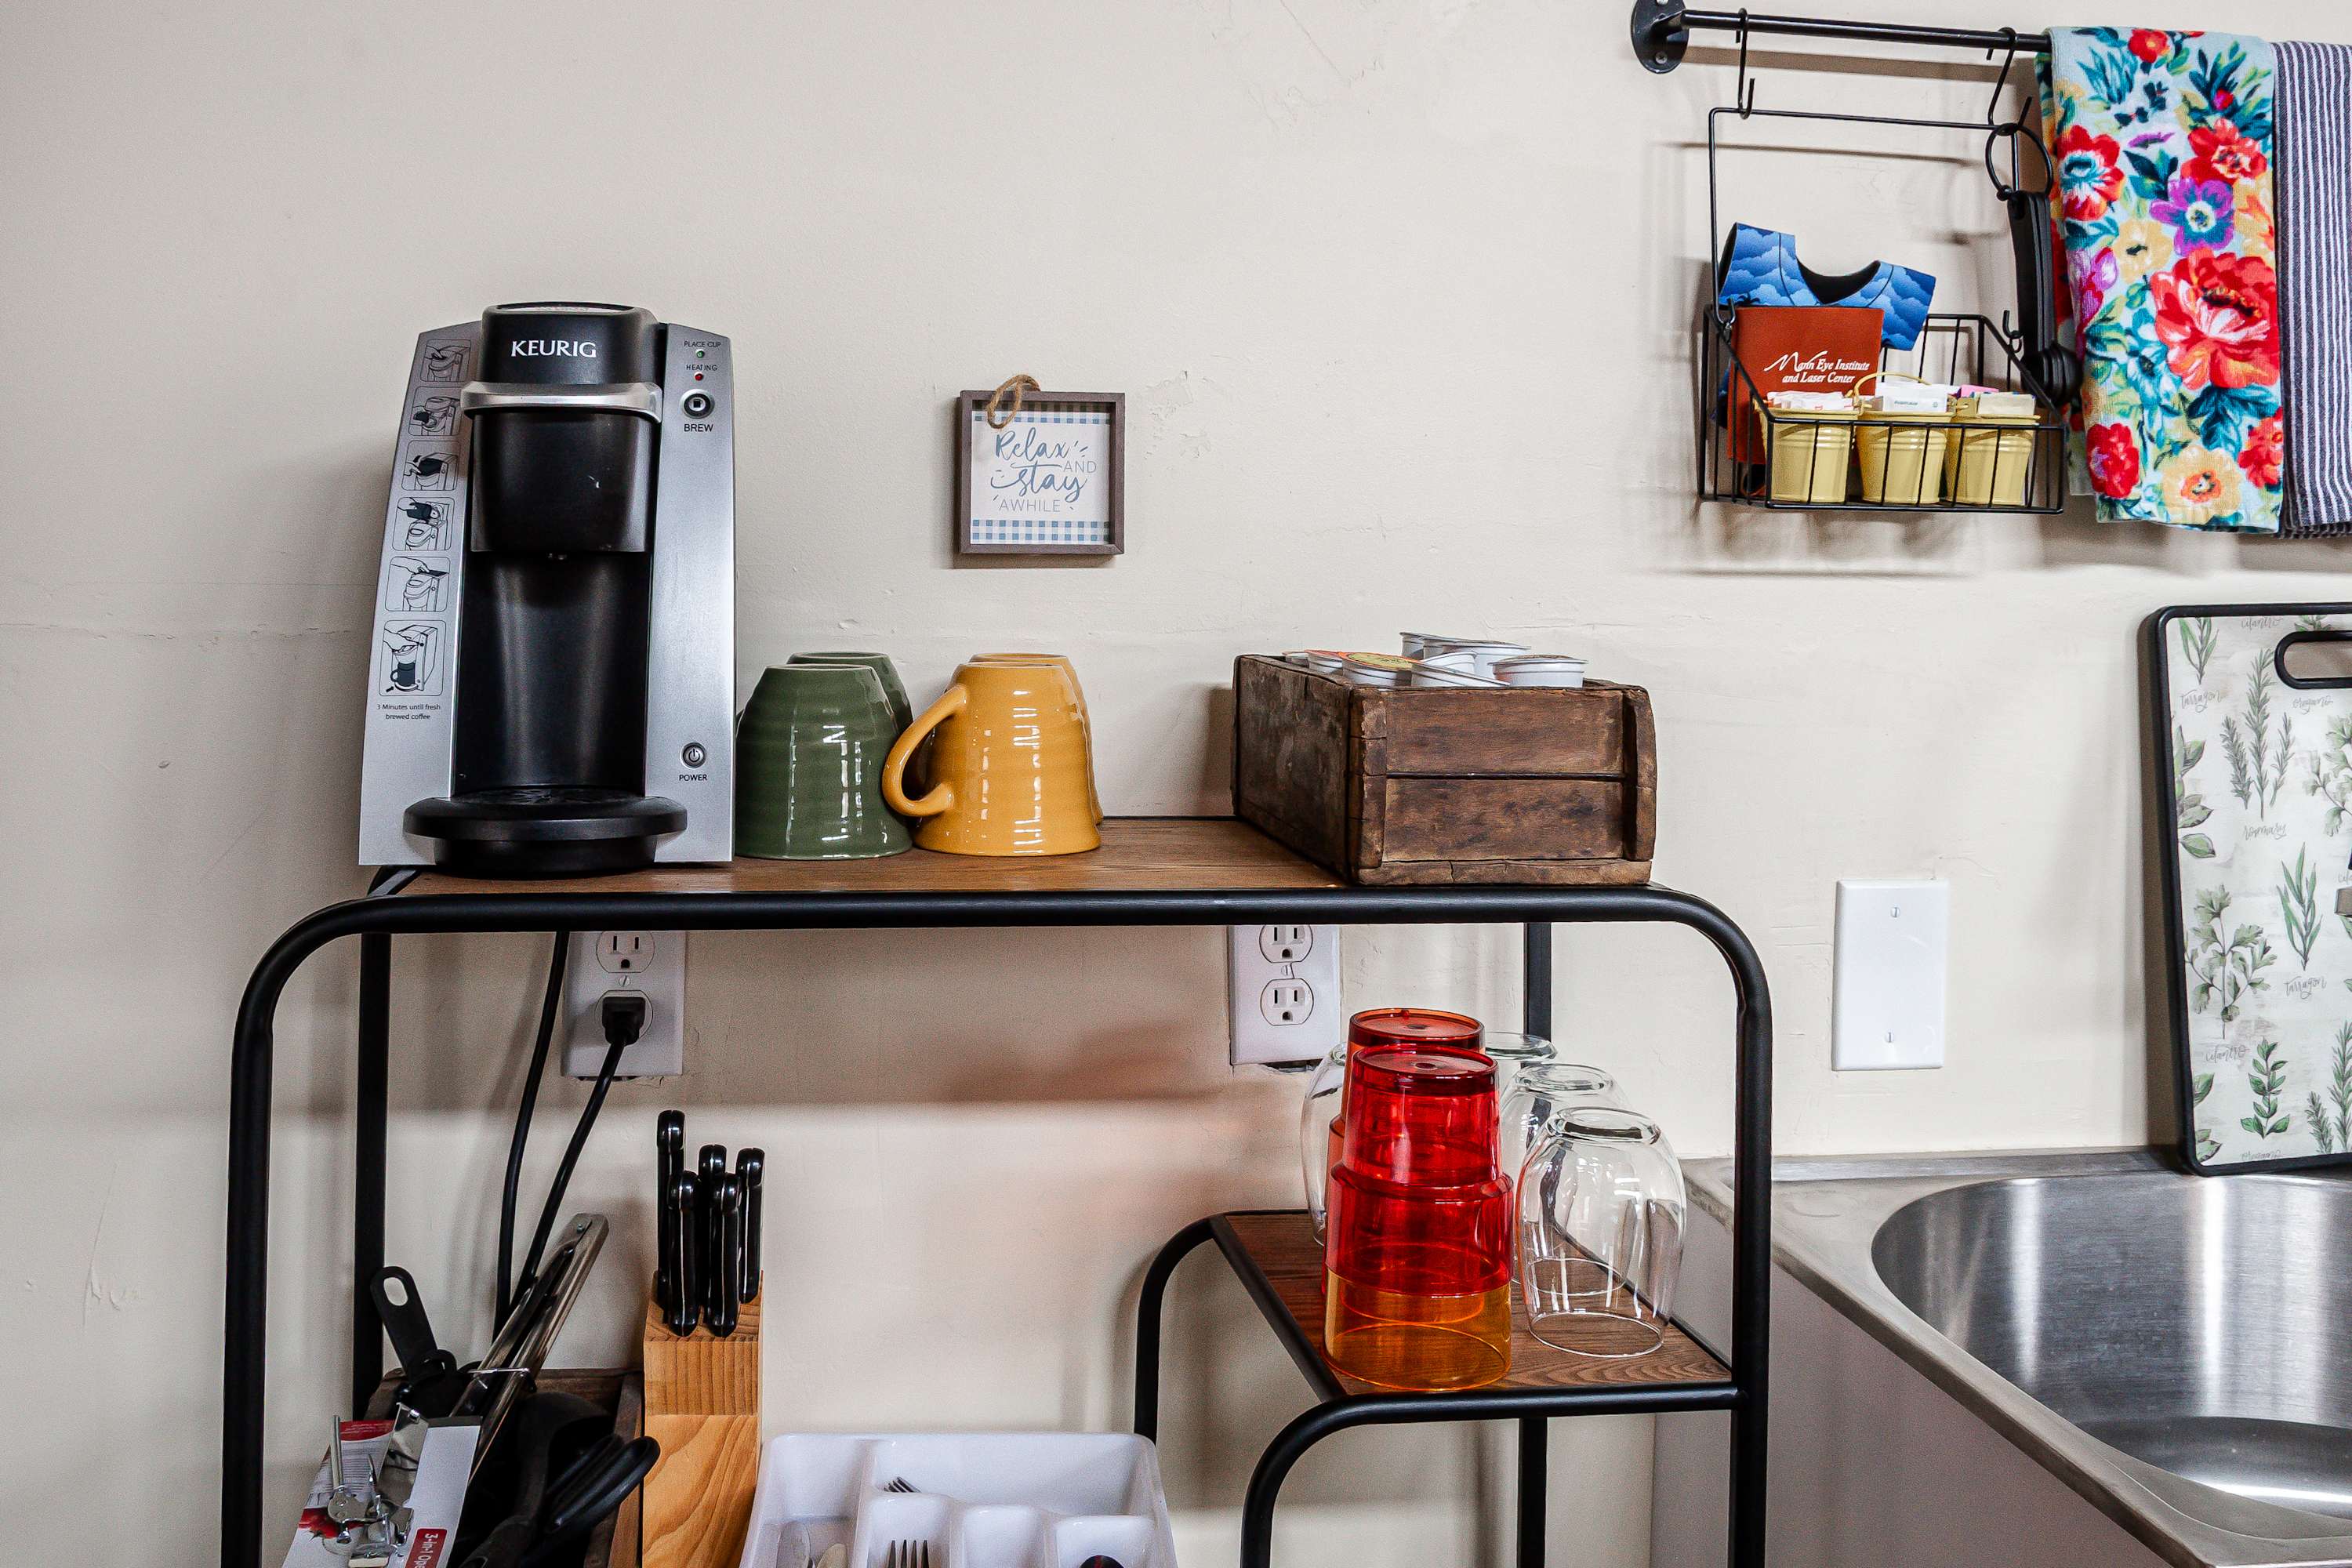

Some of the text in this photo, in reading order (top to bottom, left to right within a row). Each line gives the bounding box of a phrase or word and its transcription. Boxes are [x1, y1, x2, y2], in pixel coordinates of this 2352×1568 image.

[510, 339, 597, 358] KEURIG
[1763, 350, 1871, 372] Mann Eye Institute
[1781, 372, 1856, 383] and Laser Center
[684, 423, 714, 433] BREW
[995, 426, 1071, 462] Relax
[1062, 460, 1098, 474] AND
[990, 460, 1088, 503] stay
[998, 499, 1061, 513] AWHILE
